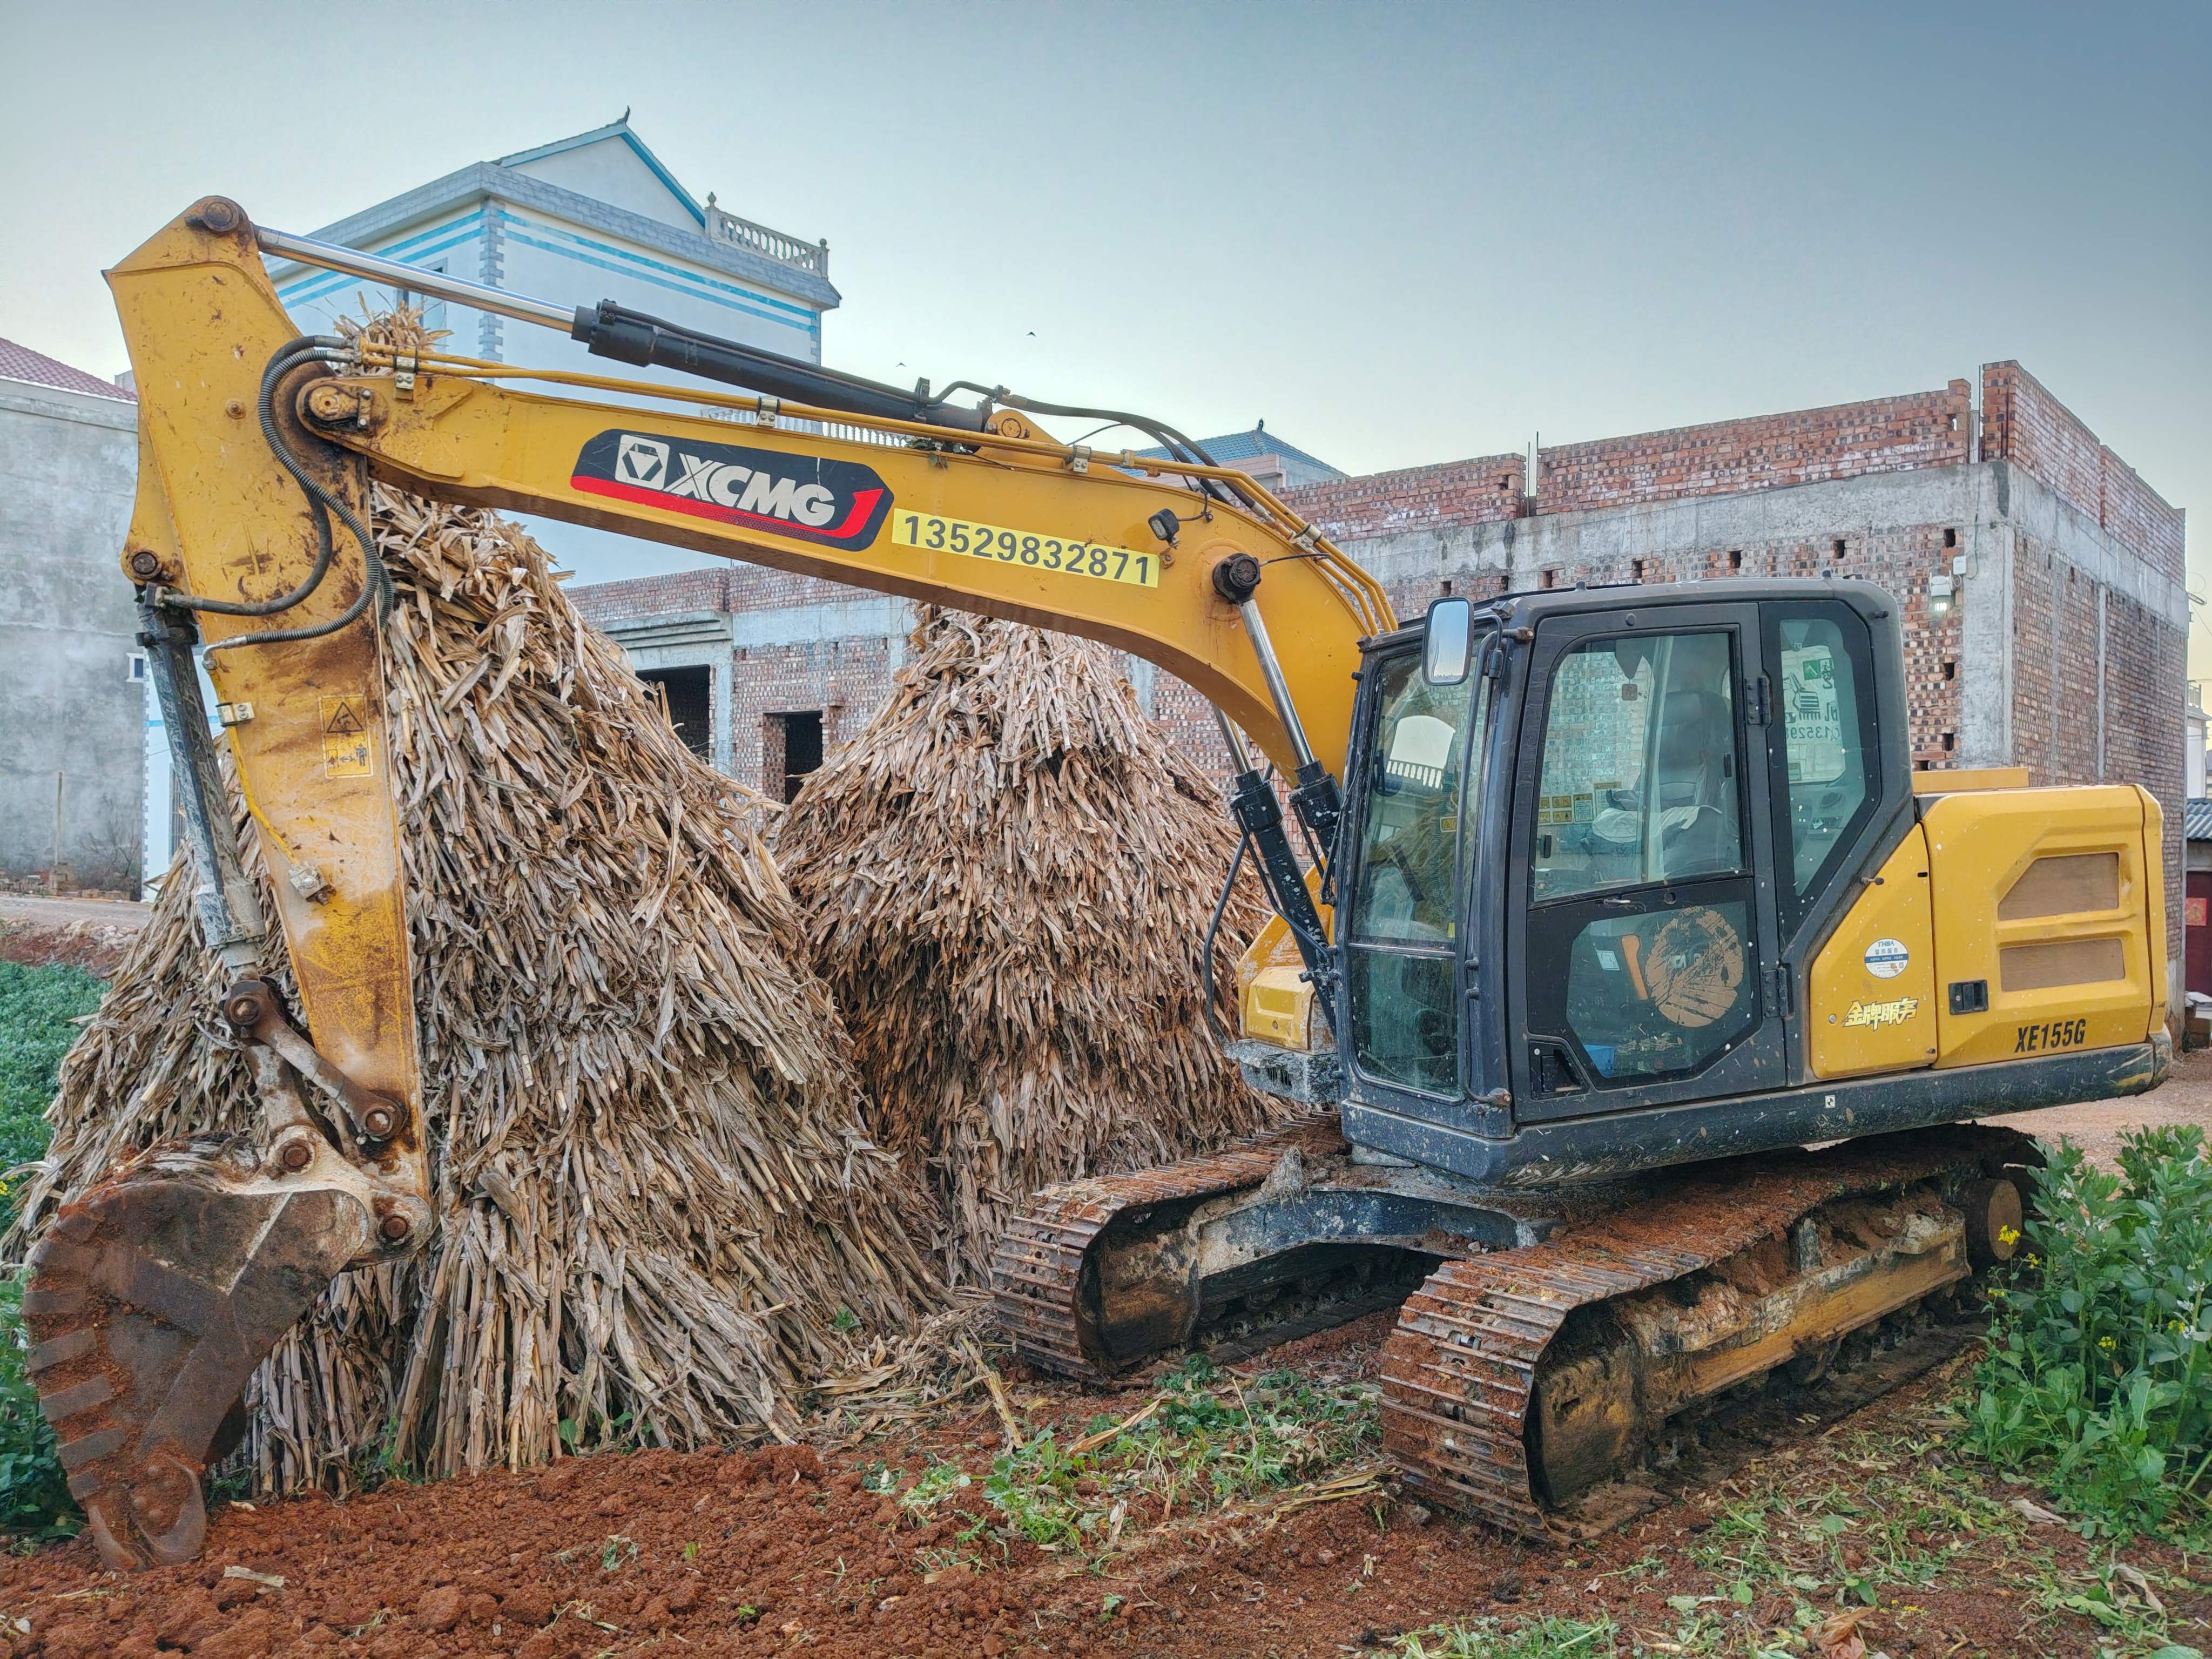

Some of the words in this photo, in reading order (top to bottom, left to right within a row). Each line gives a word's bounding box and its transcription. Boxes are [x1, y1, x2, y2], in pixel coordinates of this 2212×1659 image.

[663, 453, 835, 527] XCMG
[905, 515, 1149, 584] 13529832871
[1842, 996, 1919, 1032] 金牌服务
[2013, 1018, 2086, 1054] XE155G
